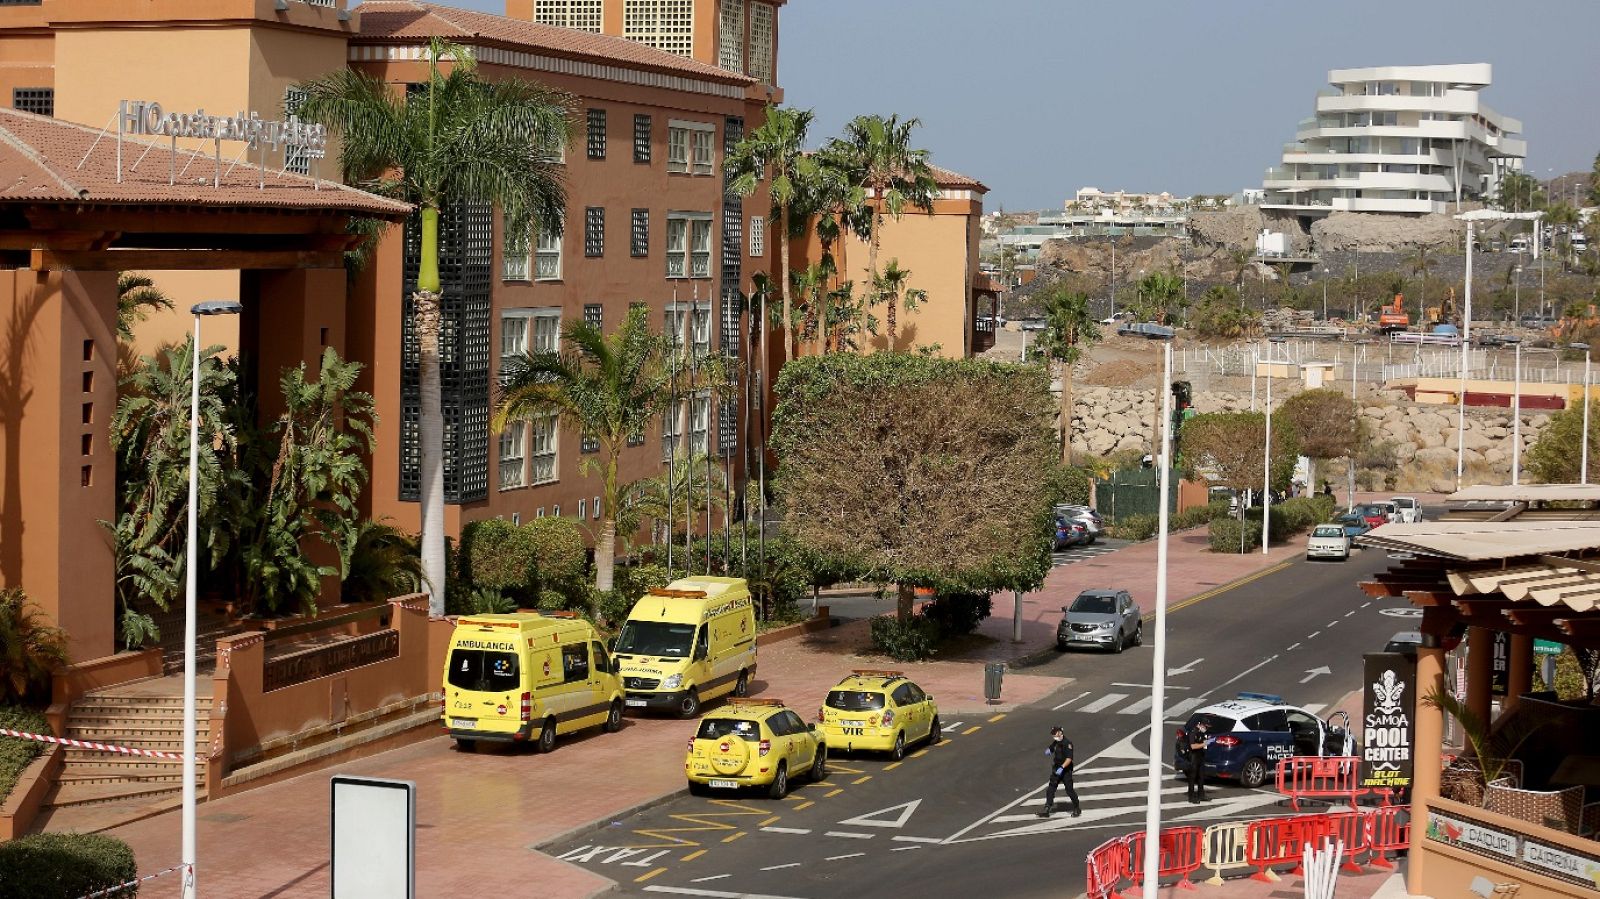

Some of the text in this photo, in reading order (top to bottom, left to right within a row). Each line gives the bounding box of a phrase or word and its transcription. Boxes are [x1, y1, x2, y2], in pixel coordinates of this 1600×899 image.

[456, 640, 515, 651] AMBULANCIA
[1366, 714, 1409, 728] SAMOA
[842, 727, 864, 736] VIR
[1364, 727, 1410, 747] POOL
[1364, 747, 1410, 762] CENTER
[1363, 777, 1411, 787] MACHINE
[554, 844, 672, 868] TAXI
